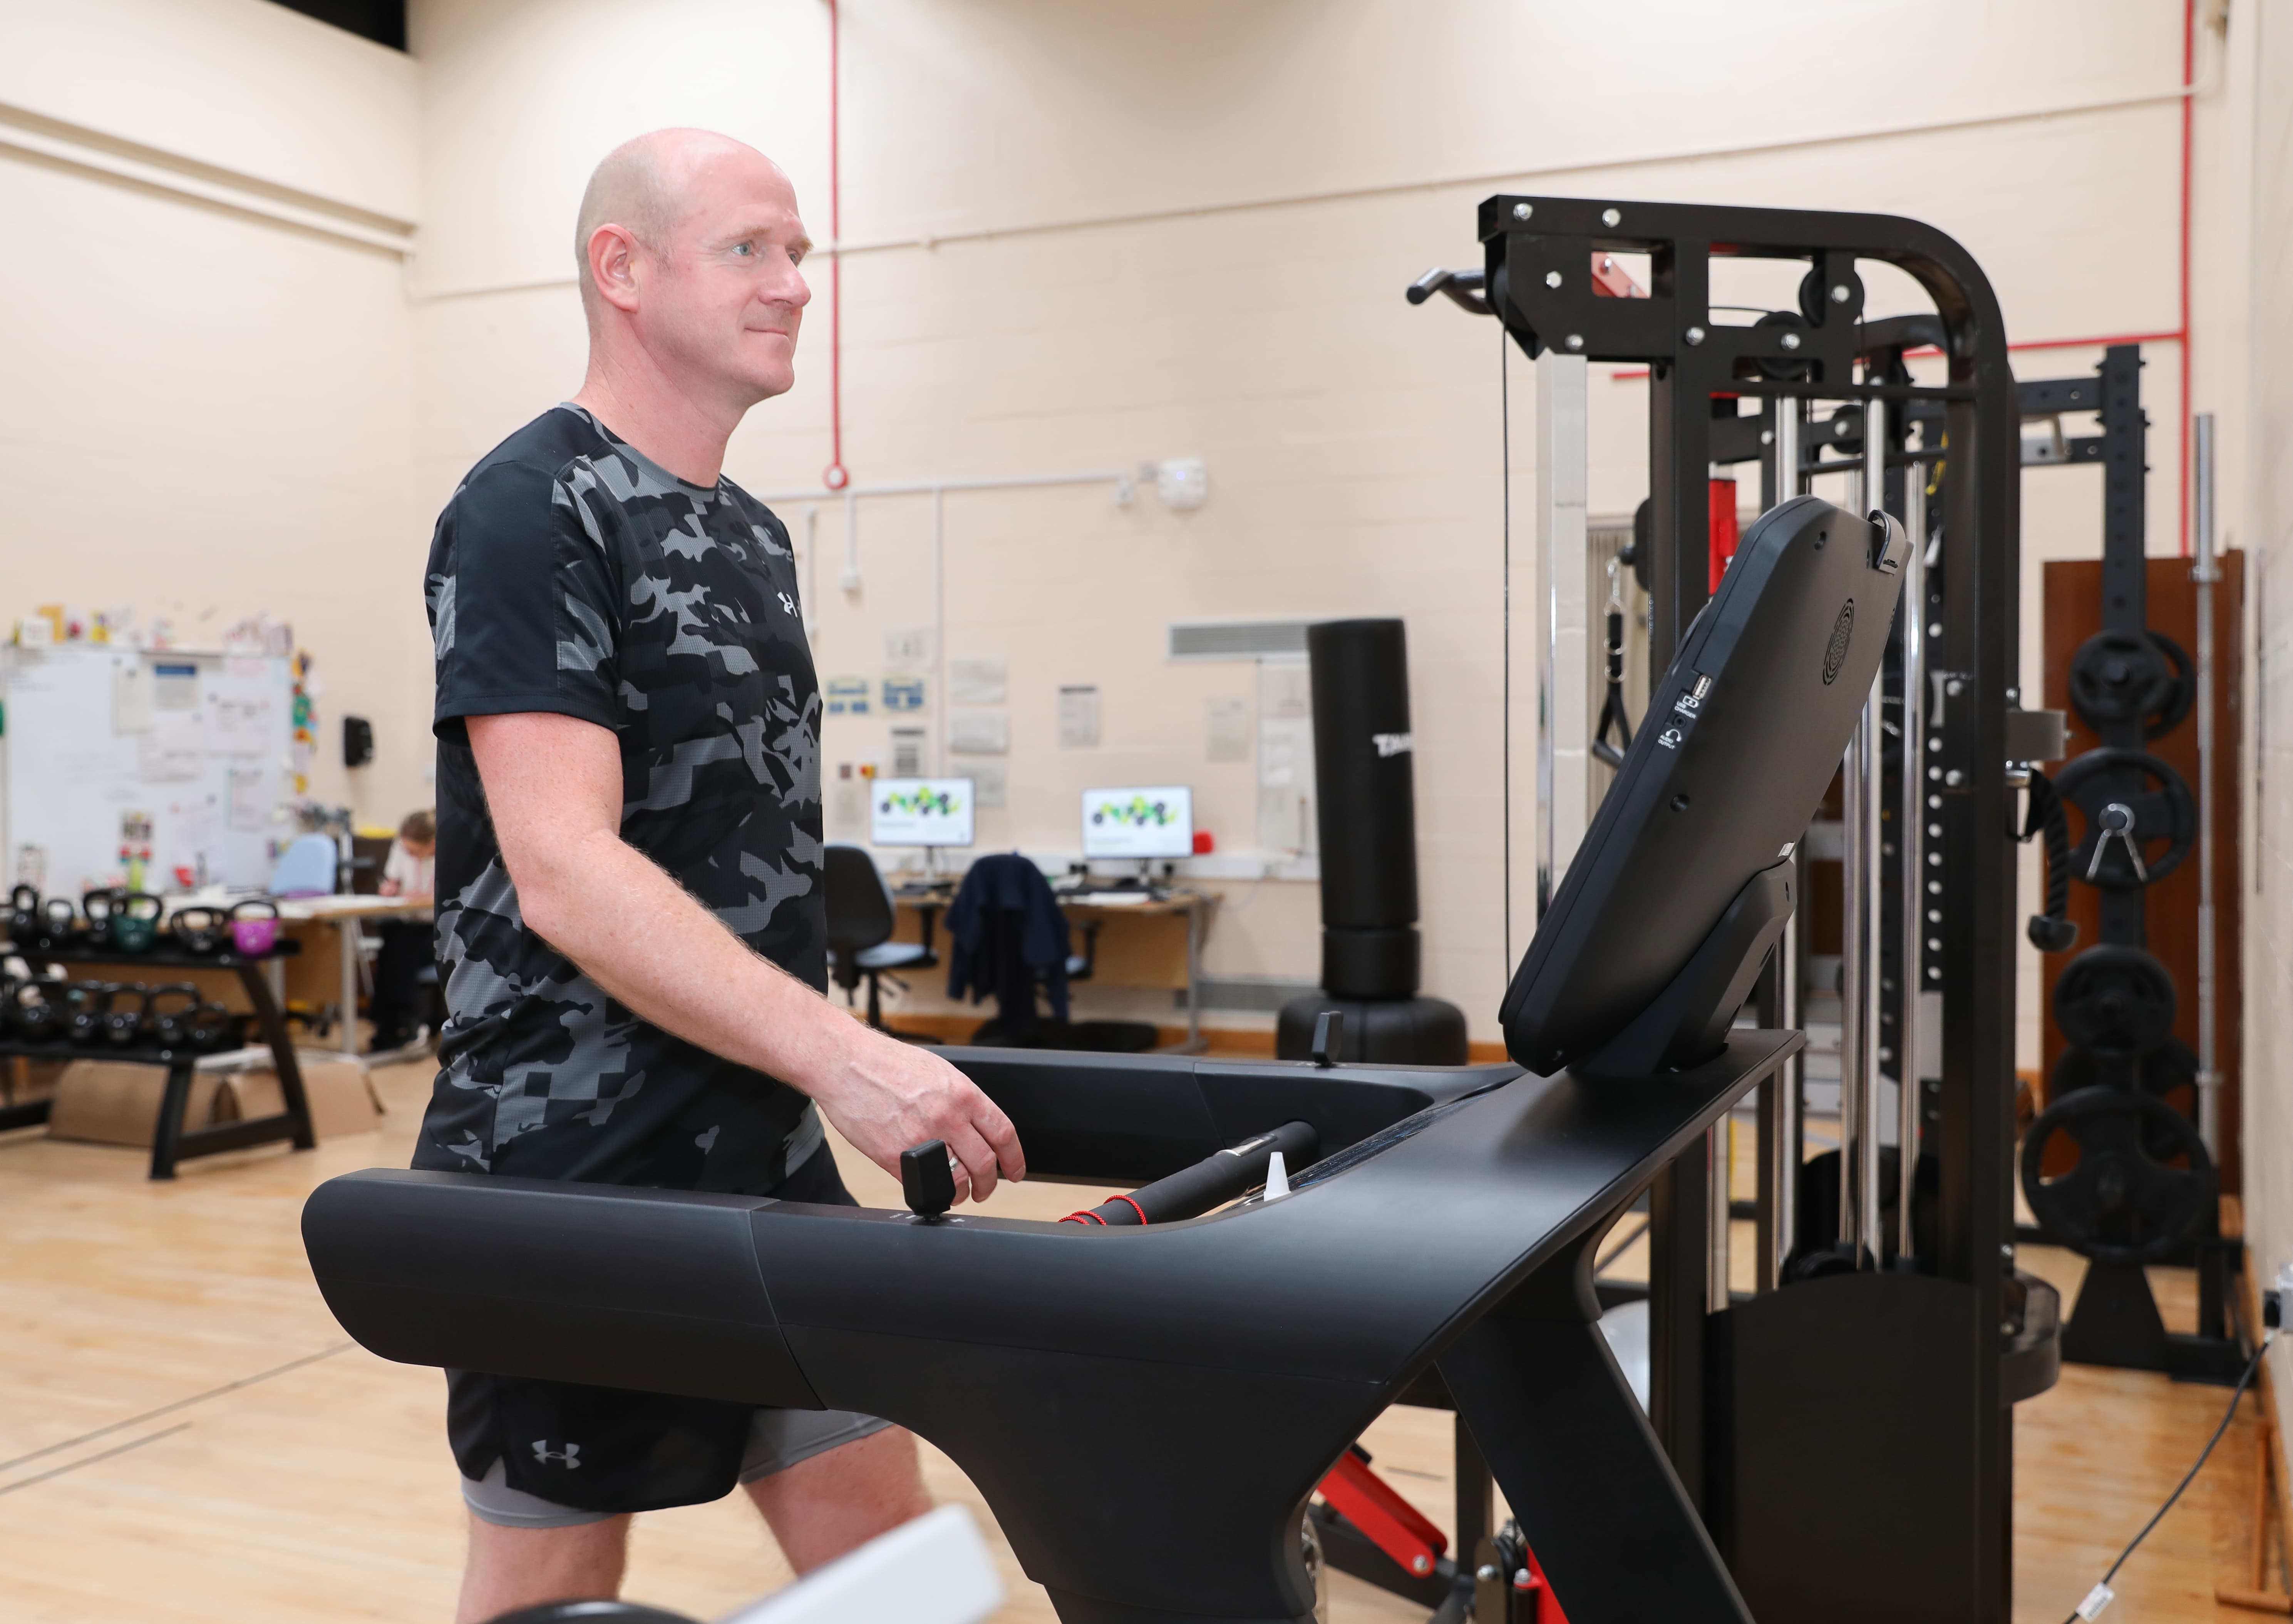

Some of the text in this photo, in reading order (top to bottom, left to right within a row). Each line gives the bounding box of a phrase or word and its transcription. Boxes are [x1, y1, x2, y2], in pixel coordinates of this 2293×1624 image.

[1675, 706, 1696, 719] CHARGER
[1660, 735, 1673, 743] AUDIO
[1658, 740, 1675, 749] OUTPUT
